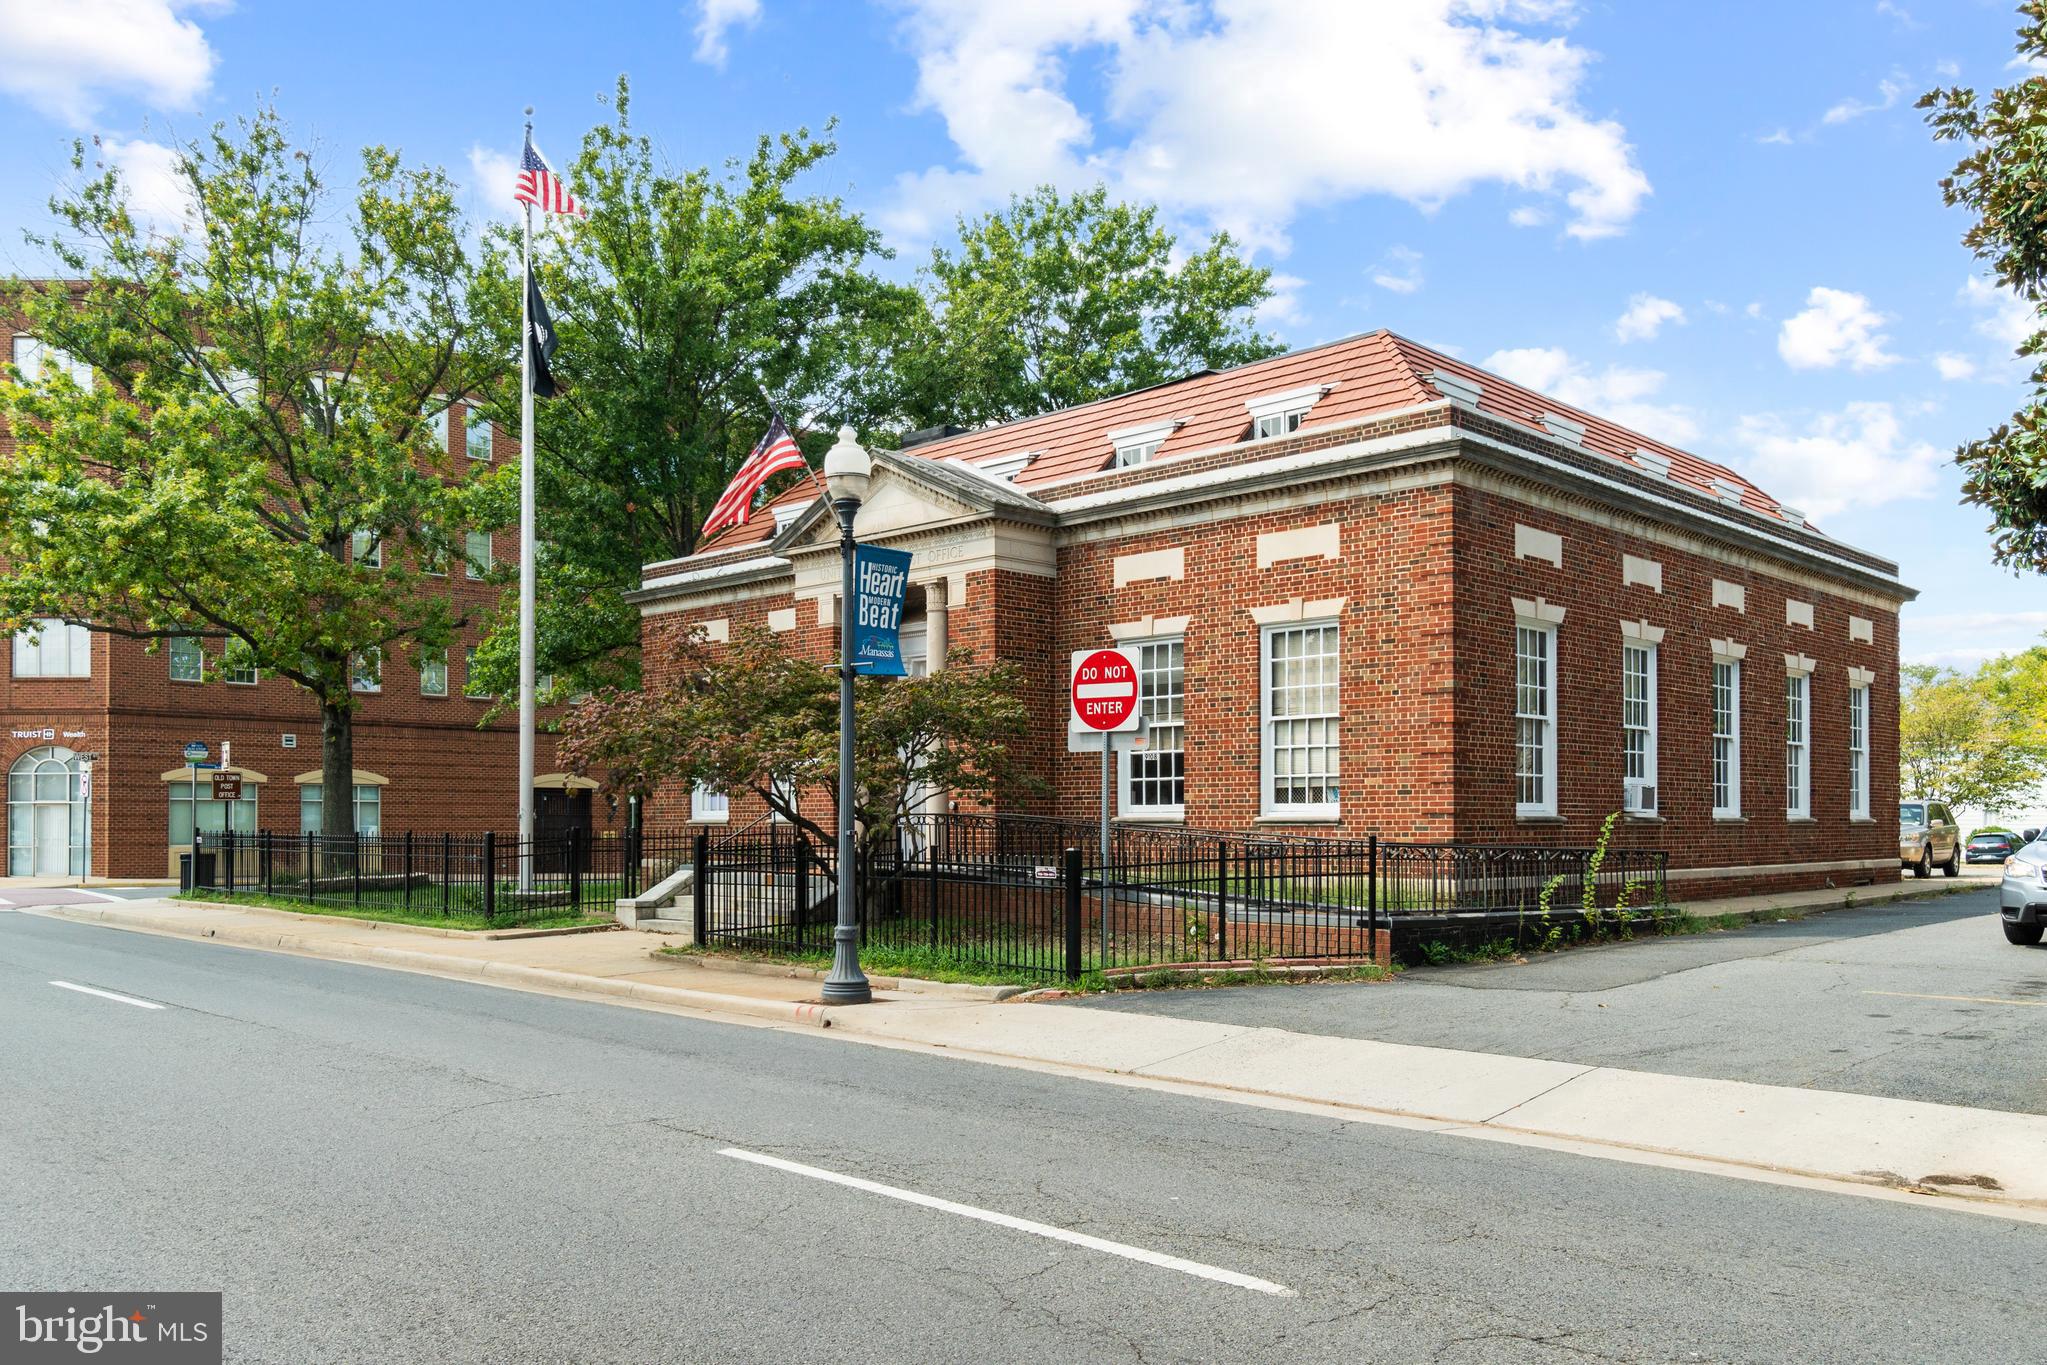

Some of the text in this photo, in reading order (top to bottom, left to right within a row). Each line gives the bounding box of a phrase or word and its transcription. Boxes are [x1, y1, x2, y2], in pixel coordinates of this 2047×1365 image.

[928, 545, 964, 563] OFFICE
[871, 562, 898, 574] HISTORIC
[860, 561, 905, 598] Heart
[868, 597, 891, 607] MODERN
[859, 594, 899, 630] Beat
[858, 644, 895, 658] Manassas
[1082, 665, 1128, 680] DO NOT
[1086, 701, 1123, 715] ENTER
[62, 730, 87, 738] Wealth
